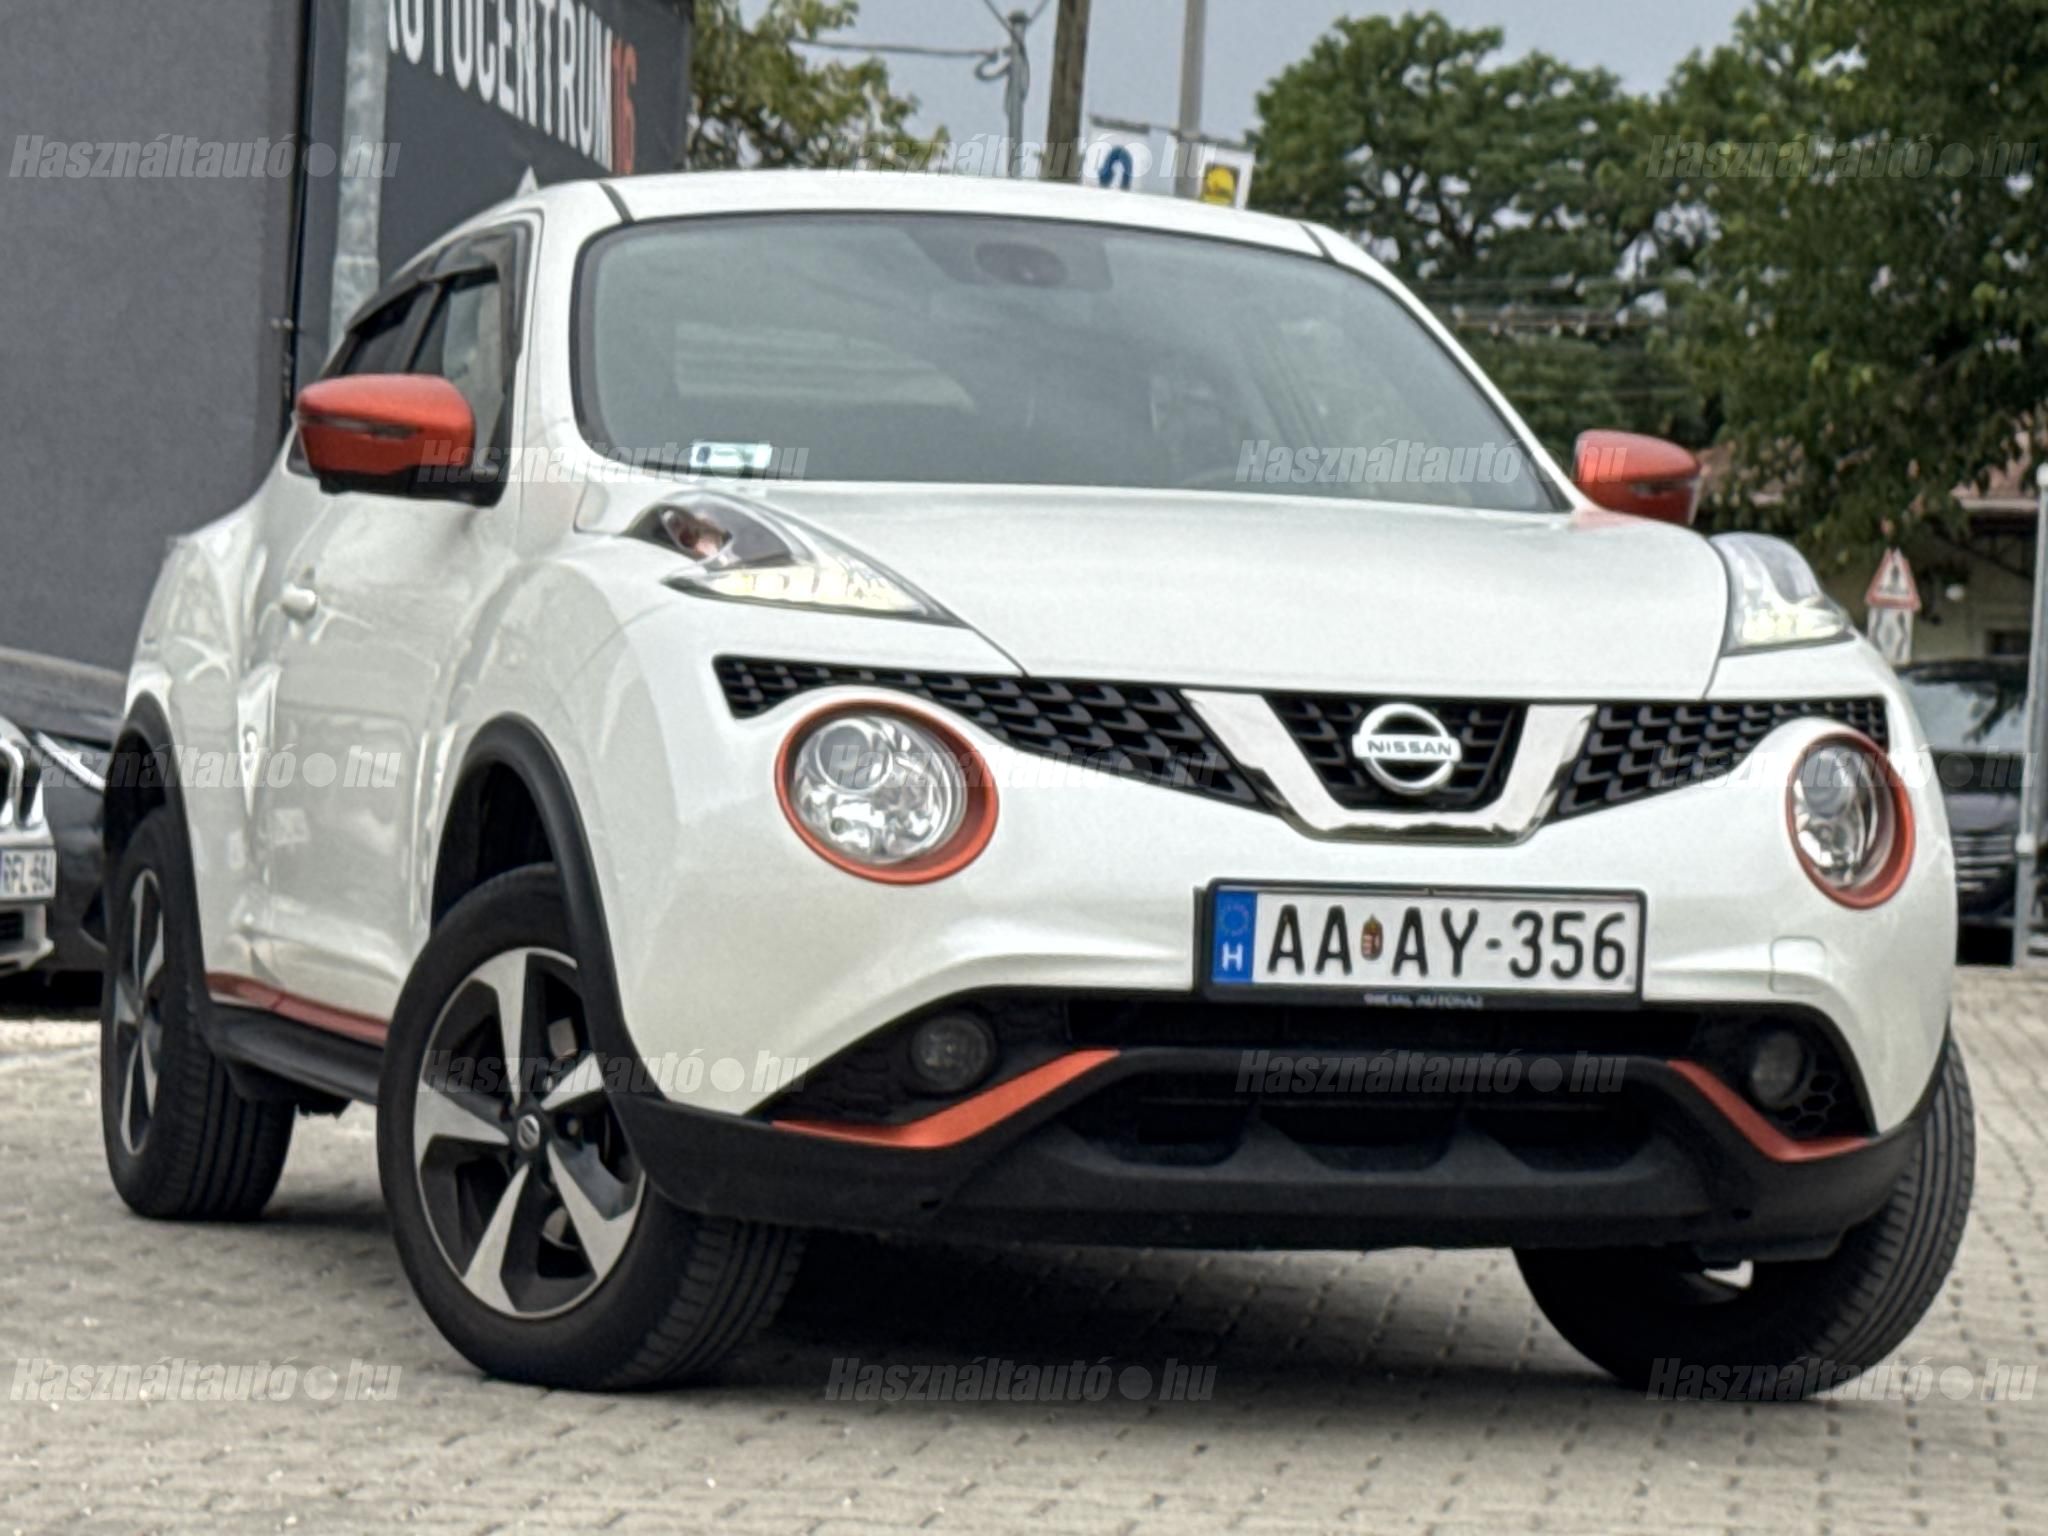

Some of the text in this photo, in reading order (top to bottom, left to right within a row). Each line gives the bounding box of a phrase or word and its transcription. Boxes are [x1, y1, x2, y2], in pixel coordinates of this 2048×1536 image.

[1367, 740, 1452, 756] NISSAN
[1221, 943, 1243, 971] H
[1392, 907, 1626, 980] AY-356
